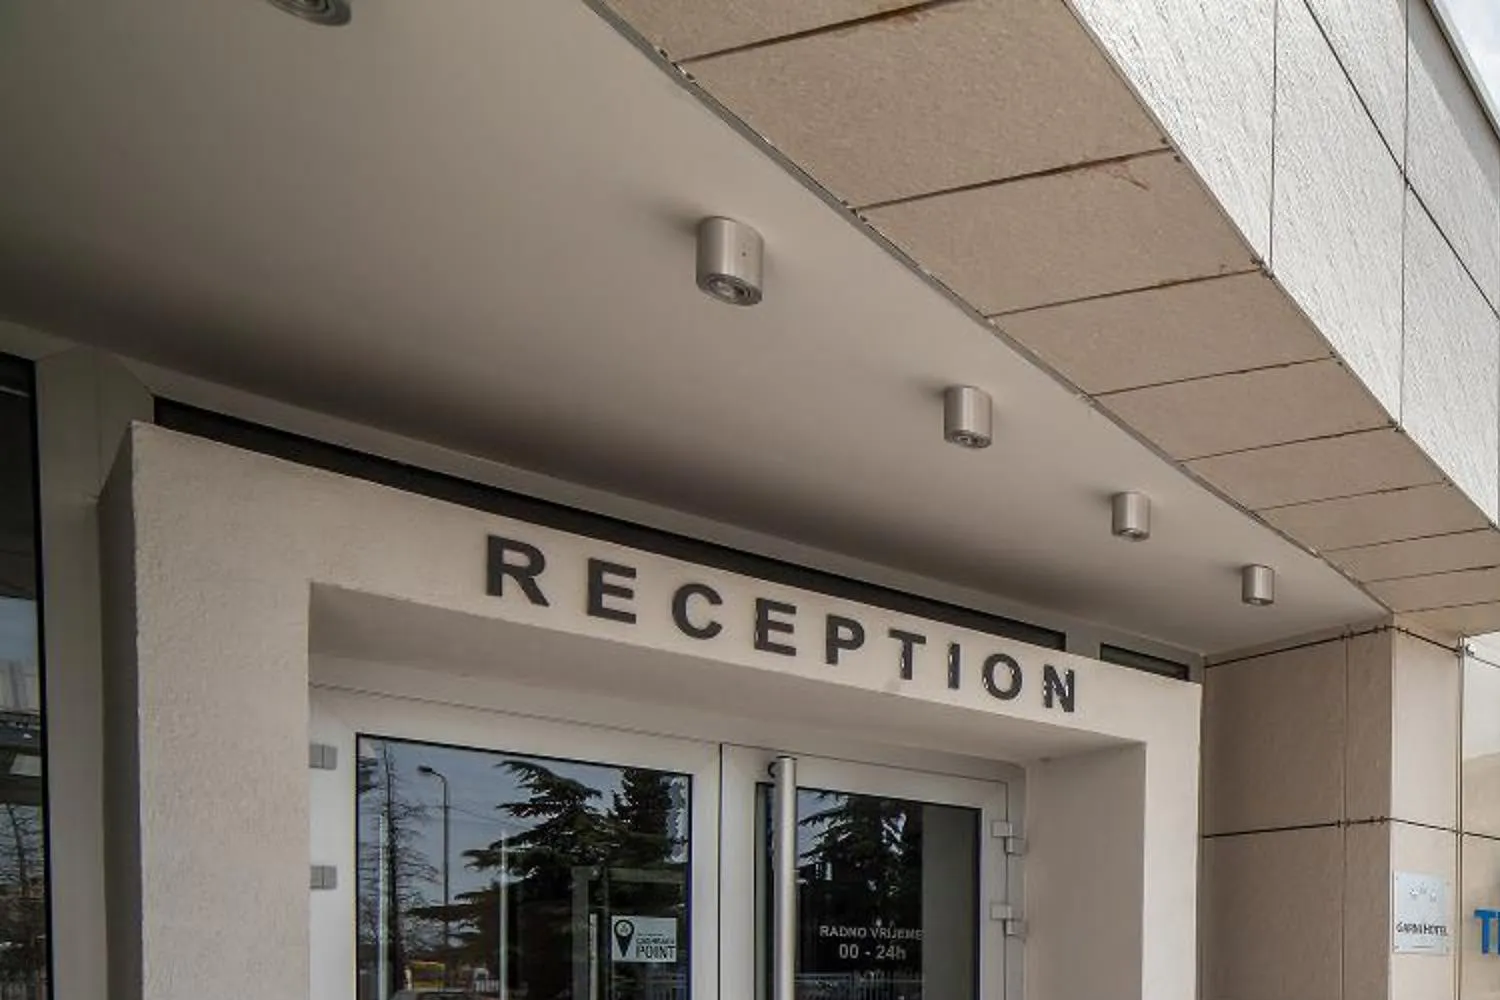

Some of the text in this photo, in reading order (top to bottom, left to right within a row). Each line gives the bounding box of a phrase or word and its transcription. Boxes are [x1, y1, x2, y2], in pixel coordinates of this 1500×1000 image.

[485, 534, 1075, 713] RECEPTION
[819, 925, 924, 940] RADNO VRIJEME
[636, 945, 676, 959] POINT
[839, 943, 859, 959] 00
[875, 944, 906, 960] 24h
